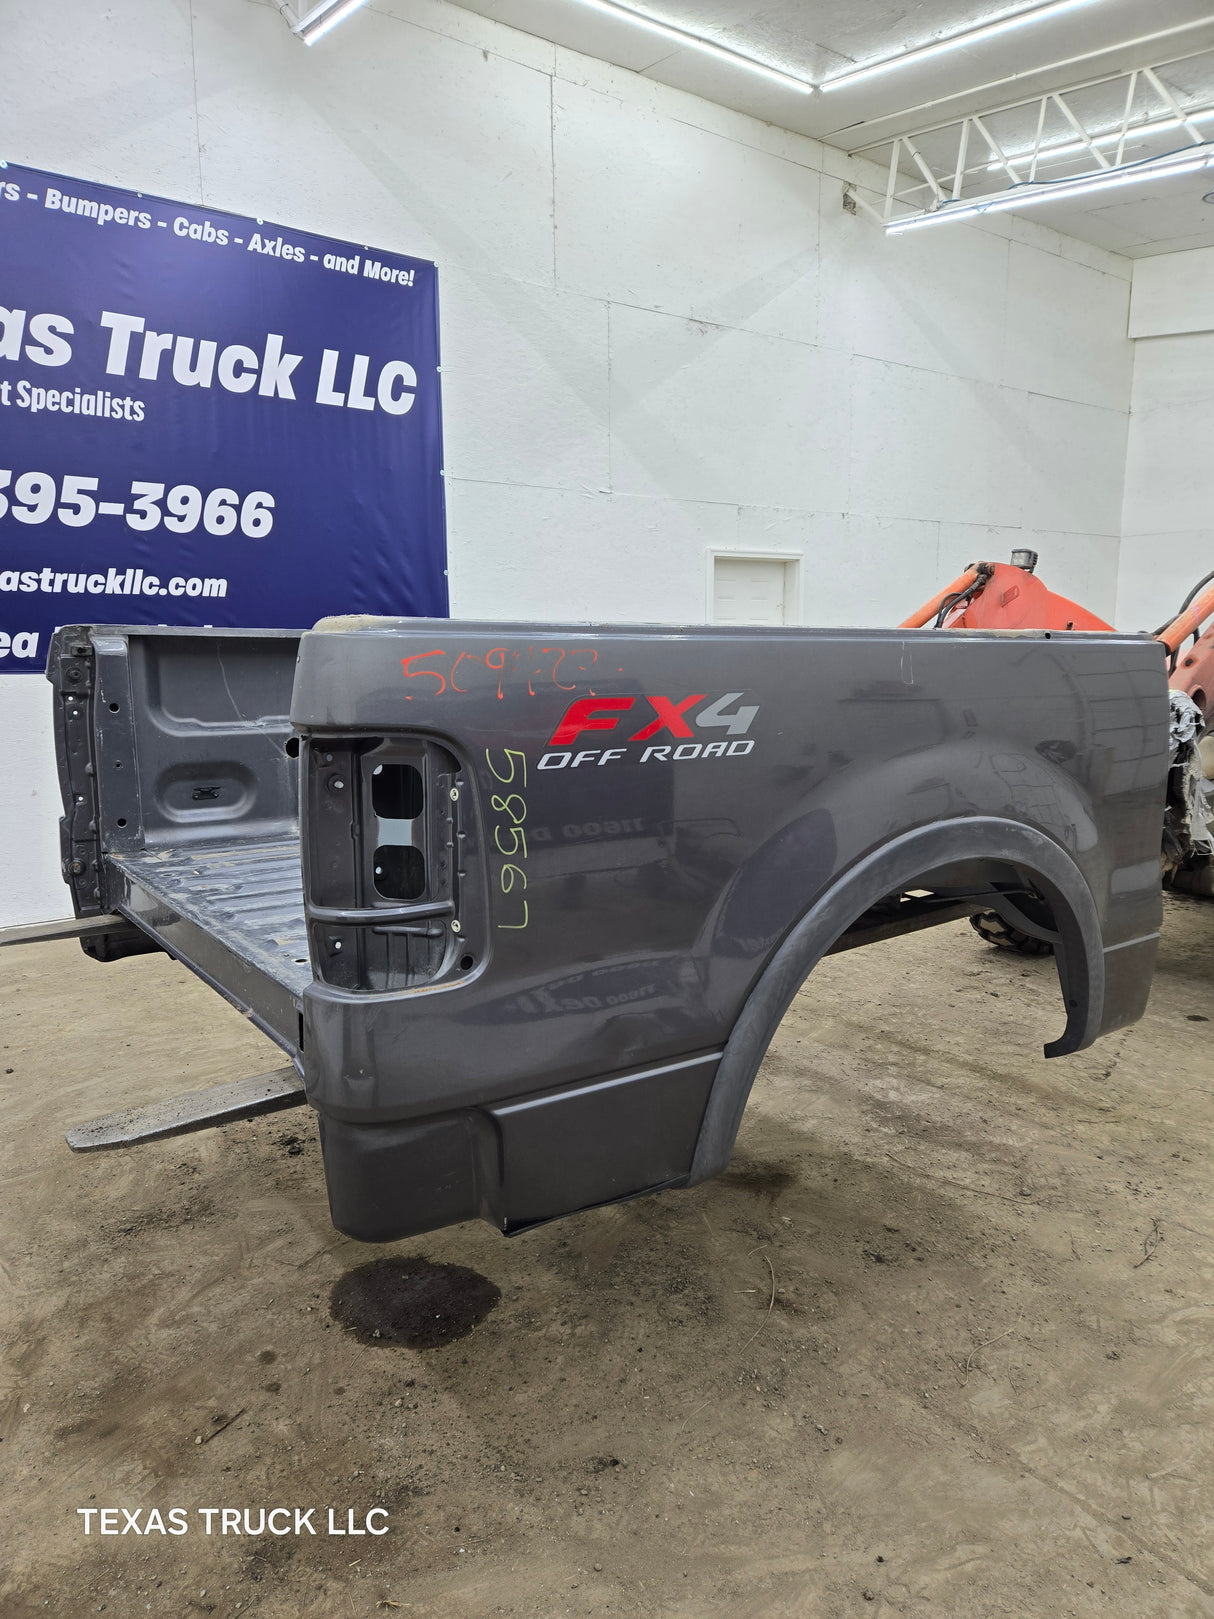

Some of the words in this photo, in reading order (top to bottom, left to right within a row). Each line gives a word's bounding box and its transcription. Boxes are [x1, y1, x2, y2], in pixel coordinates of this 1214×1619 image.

[44, 187, 152, 229] Bumpers
[173, 216, 229, 246] Cabs
[247, 232, 306, 263] Axles
[323, 252, 360, 275] and
[363, 259, 415, 287] More!
[100, 310, 304, 401] Truck
[315, 348, 418, 416] LLC
[15, 380, 146, 422] Specialists
[0, 567, 228, 598] astruckllc.com
[548, 692, 760, 746] FX4
[537, 748, 628, 770] OFF
[639, 740, 755, 763] ROAD
[486, 748, 529, 929] 58567
